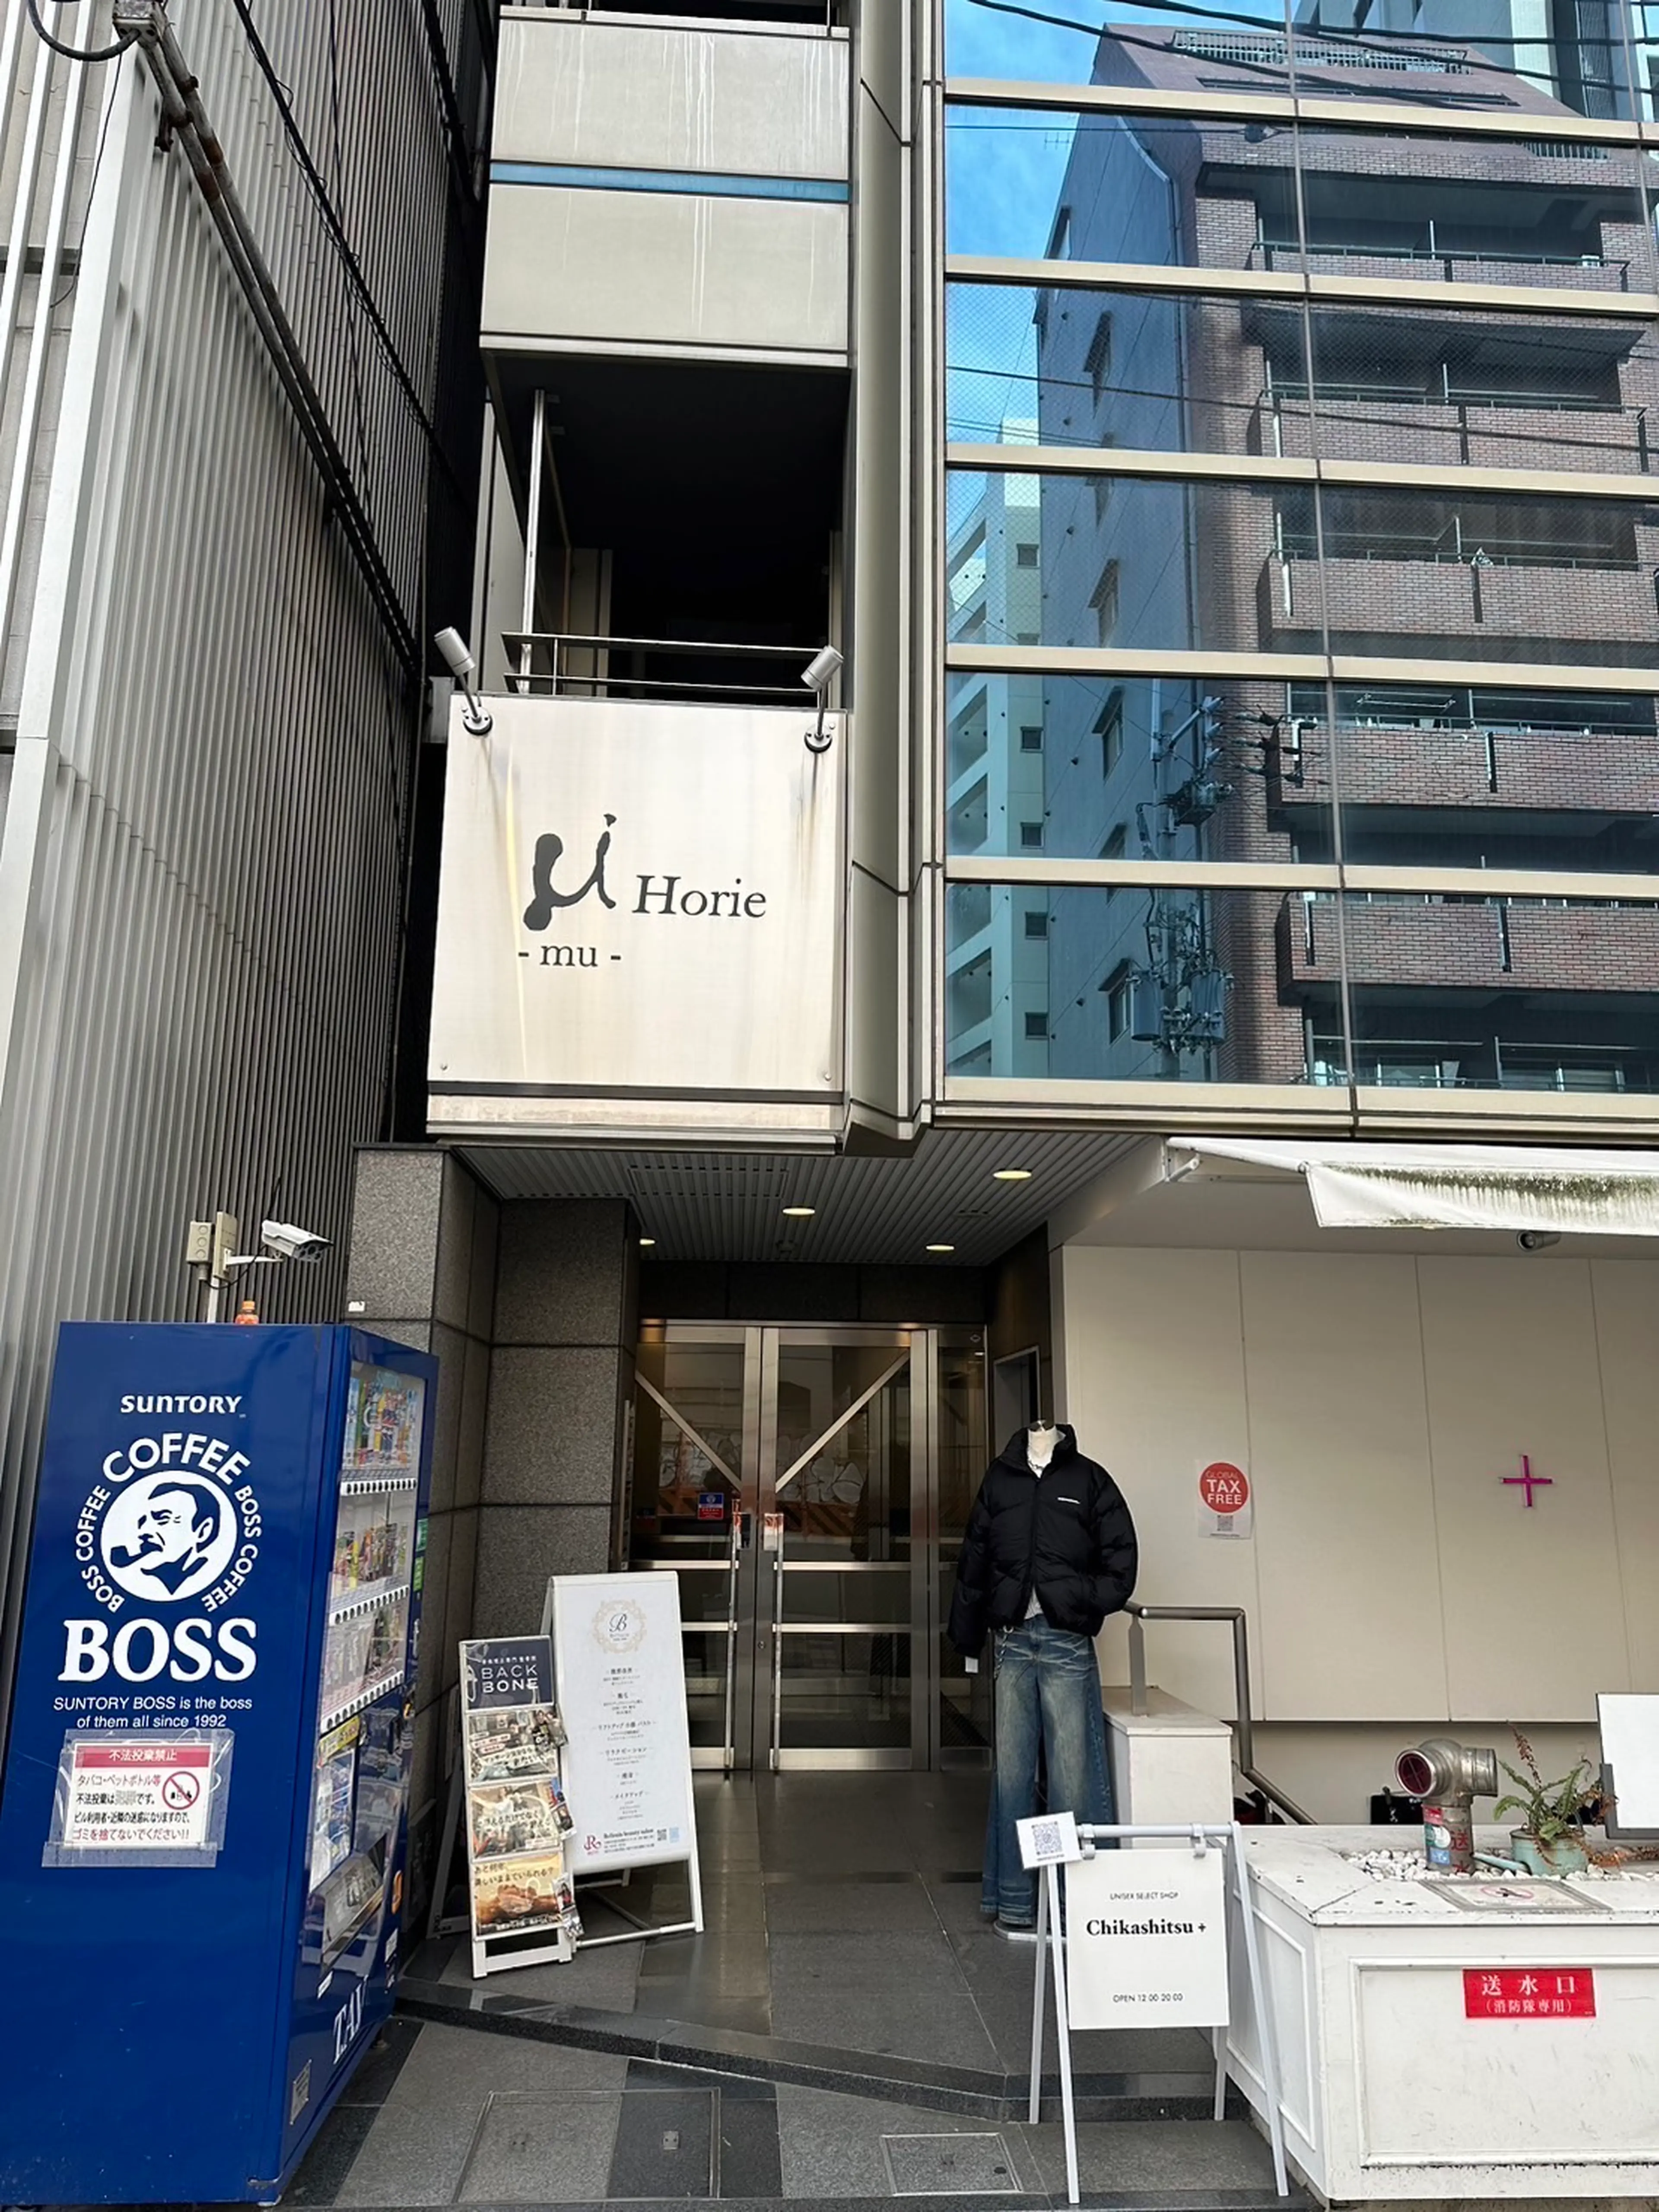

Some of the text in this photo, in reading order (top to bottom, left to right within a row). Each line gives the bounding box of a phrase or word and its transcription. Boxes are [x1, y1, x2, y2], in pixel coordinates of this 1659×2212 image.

[632, 875, 766, 918] Horie
[540, 945, 598, 968] mu
[121, 1395, 242, 1413] SUNTORY
[103, 1432, 251, 1485] COFFEE
[1206, 1479, 1241, 1493] TAX
[1207, 1493, 1243, 1505] FREE
[76, 1485, 125, 1613] BOSS COFFEE
[201, 1485, 262, 1612] BOSS COFFEE
[57, 1618, 257, 1681] BOSS
[481, 1664, 538, 1680] BACK
[482, 1678, 539, 1693] BONE
[54, 1696, 252, 1710] SUNTORY BOSS is the boss
[77, 1715, 226, 1728] of them all since 1992
[109, 1749, 178, 1762] 不法投棄禁止
[1136, 1892, 1159, 1900] SELECT
[1160, 1891, 1179, 1899] SHOP
[1086, 1918, 1194, 1936] Chikashitsu
[1481, 1975, 1575, 1996] 送水口
[1112, 1995, 1135, 2003] OPEN
